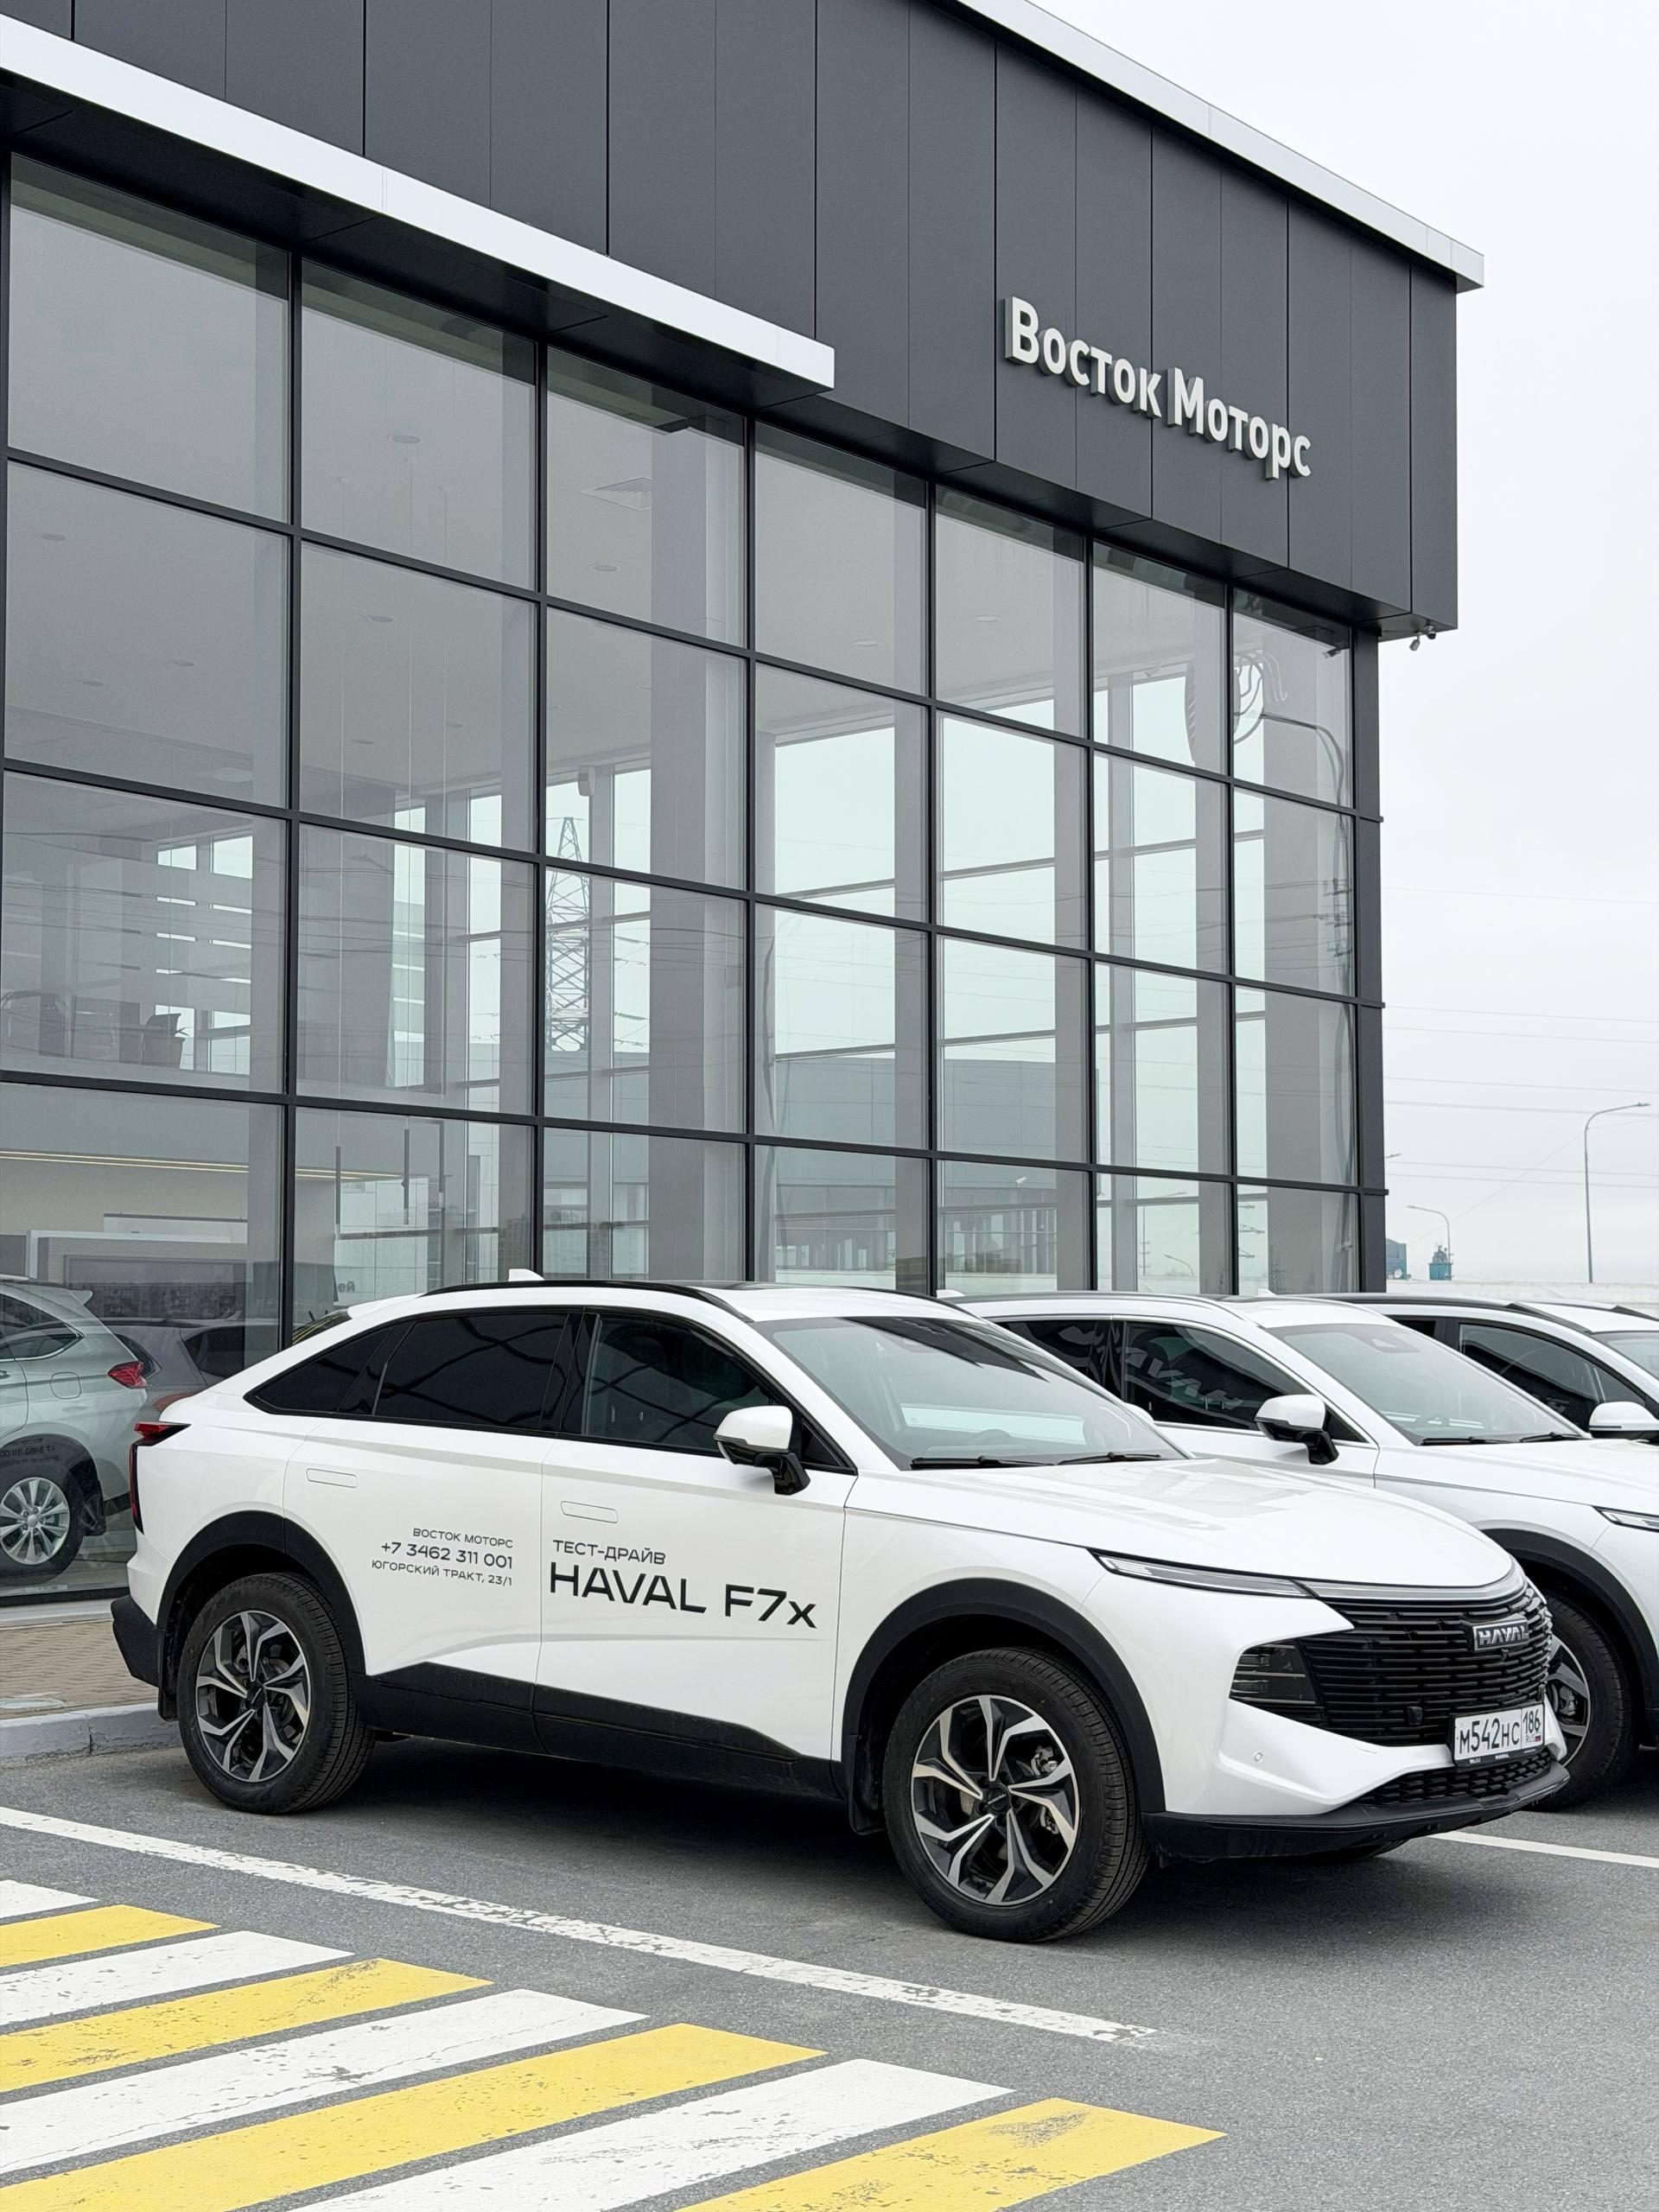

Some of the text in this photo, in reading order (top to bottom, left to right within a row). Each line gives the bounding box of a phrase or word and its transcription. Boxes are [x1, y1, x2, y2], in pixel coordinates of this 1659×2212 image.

[1005, 296, 1312, 480] Восток Моторс
[413, 1528, 513, 1548] ВОСТОК МОТОРС
[381, 1541, 512, 1569] +7 3462 311 001
[553, 1540, 666, 1565] ТЕСТ-ДРАЙВ
[372, 1560, 512, 1587] ЮГОРСКИЙ ТРАКТ, 23/1
[550, 1561, 817, 1629] HAVAL F7x
[1478, 1625, 1529, 1645] HAVAL
[1522, 1708, 1541, 1734] 186
